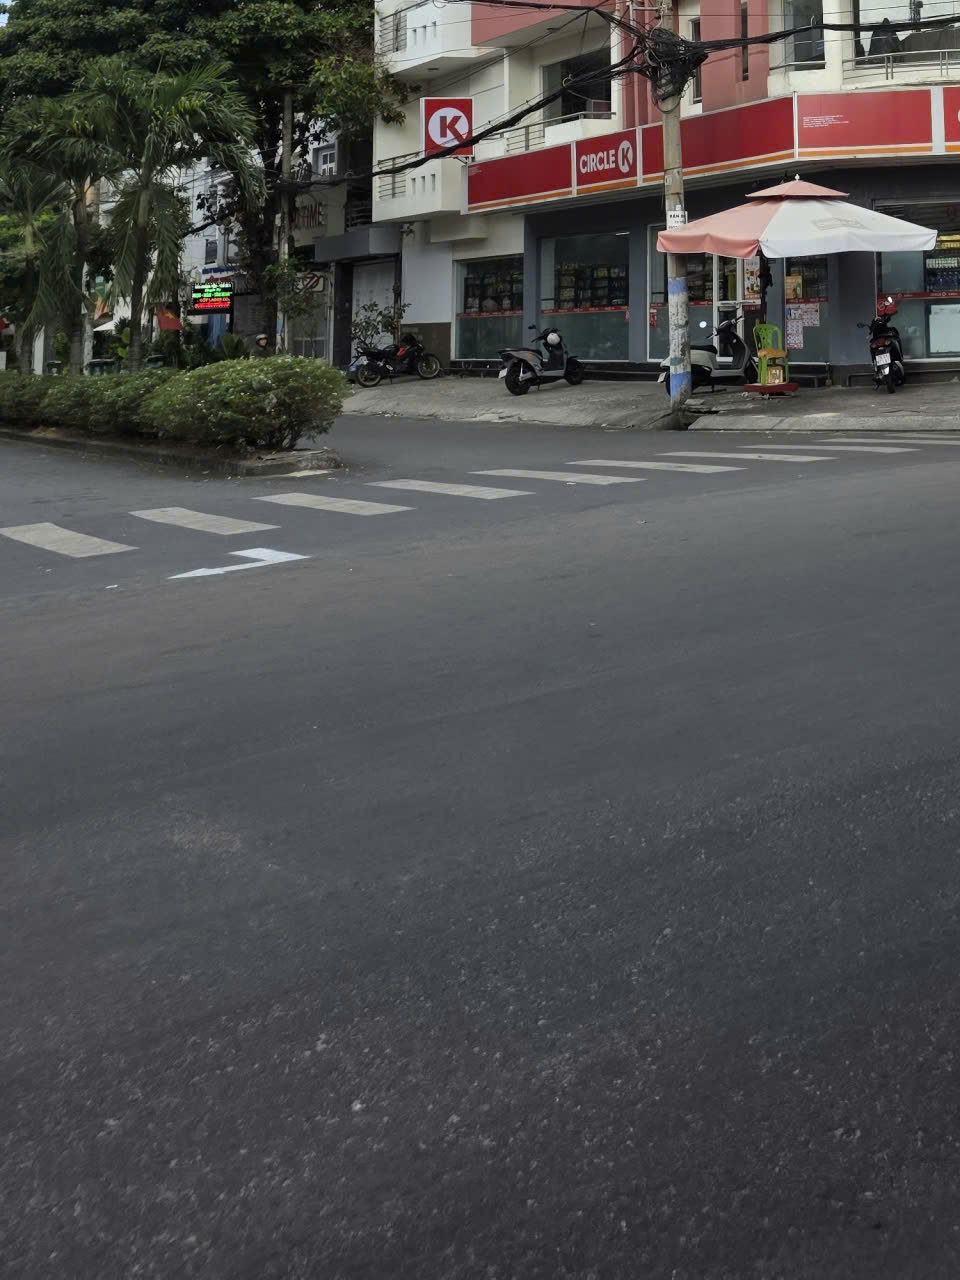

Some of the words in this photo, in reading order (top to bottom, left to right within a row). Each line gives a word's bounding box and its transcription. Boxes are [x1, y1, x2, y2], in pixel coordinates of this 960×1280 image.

[434, 111, 469, 147] K
[580, 149, 616, 173] CIRCLE
[618, 142, 633, 173] K
